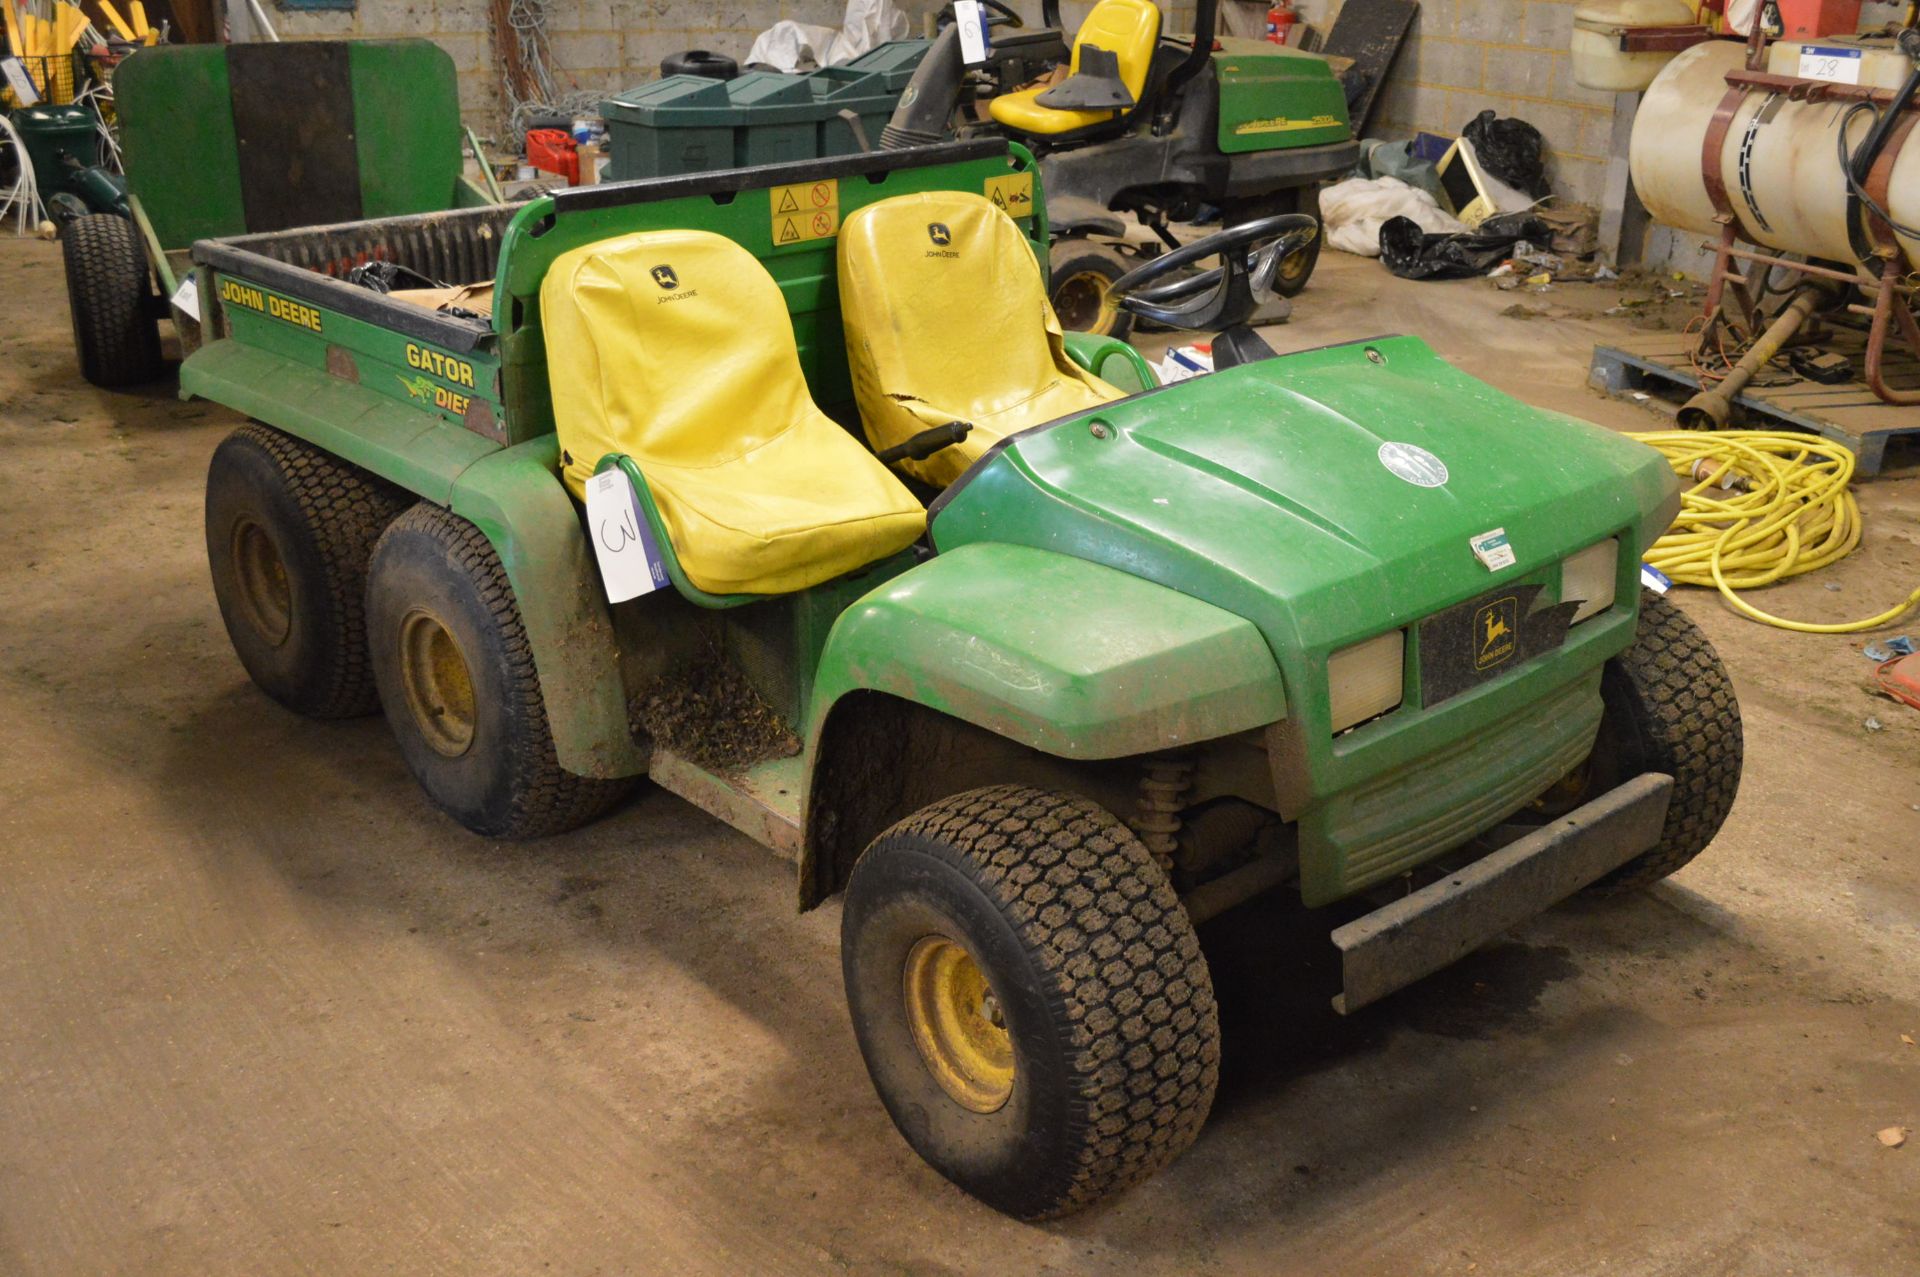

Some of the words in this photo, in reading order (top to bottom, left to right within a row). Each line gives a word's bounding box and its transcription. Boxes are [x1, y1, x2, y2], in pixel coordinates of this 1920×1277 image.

[924, 250, 941, 258] JOHN
[942, 250, 960, 258] DEERE
[222, 281, 264, 312] JOHN
[268, 295, 322, 333] DEERE
[656, 296, 674, 305] JOHN
[673, 289, 698, 301] DEERE
[406, 342, 475, 389] GATOR
[601, 508, 636, 553] 3
[1478, 651, 1494, 664] JOHN
[1495, 641, 1512, 658] DEERE
